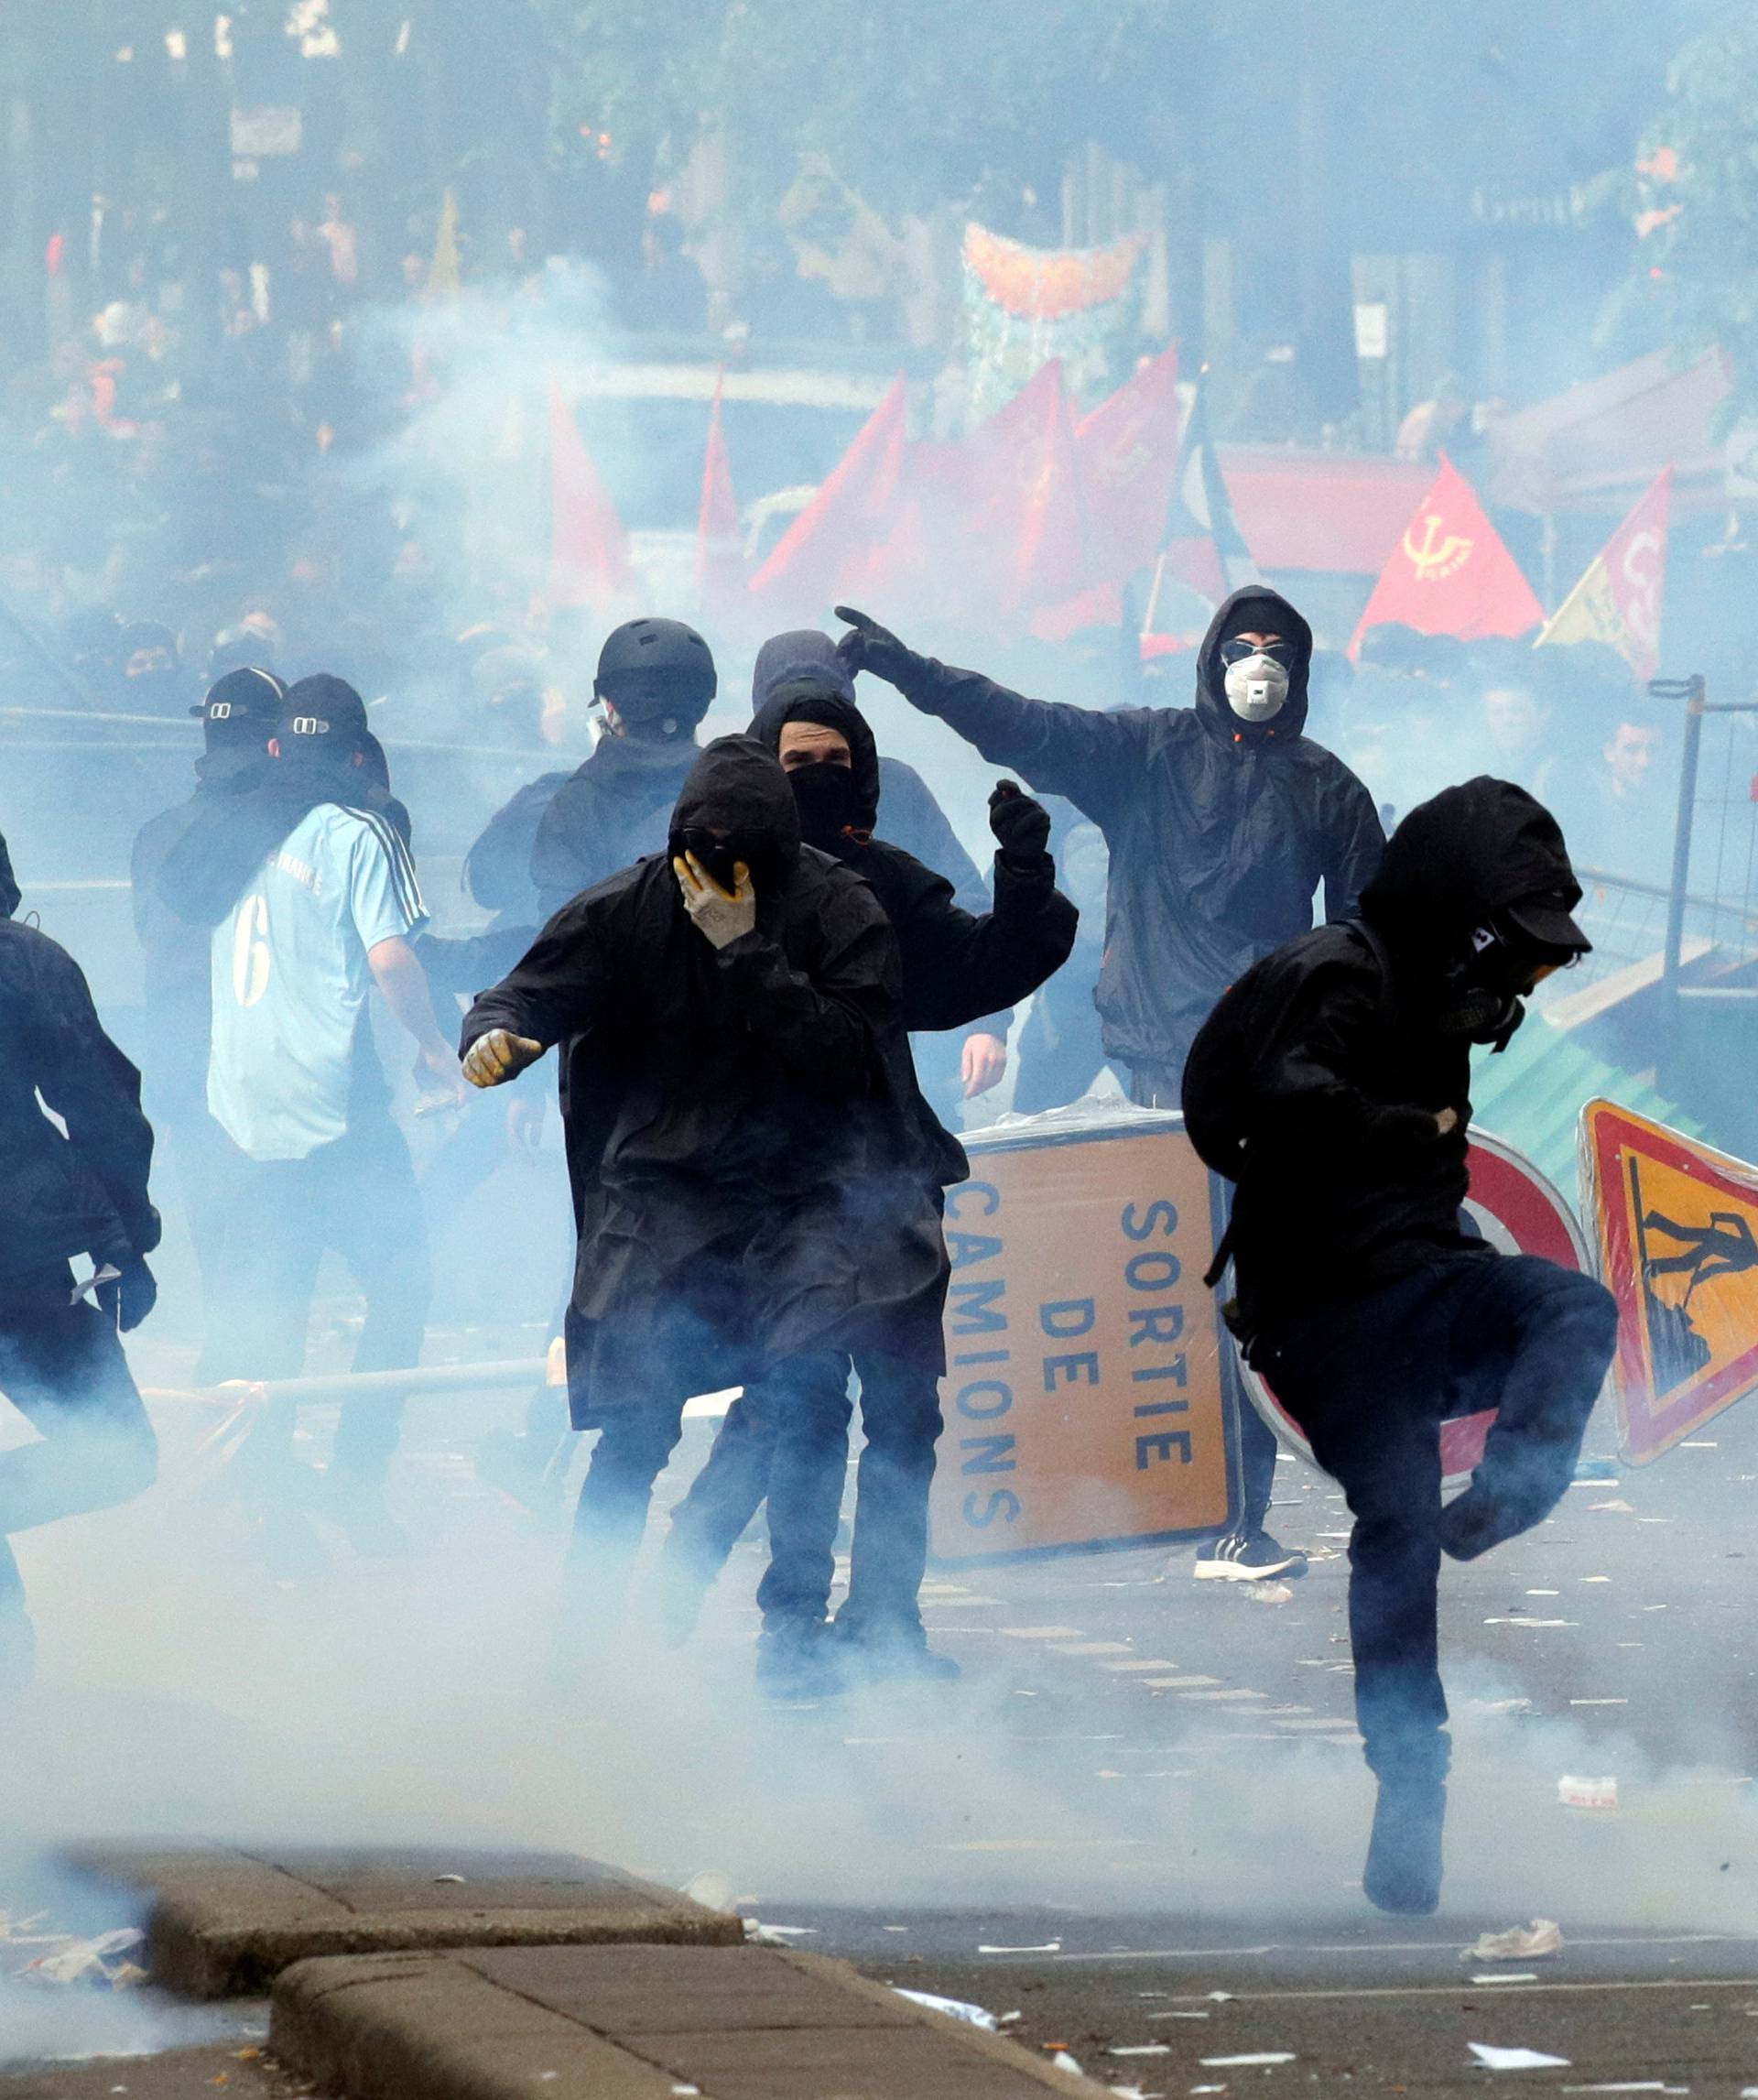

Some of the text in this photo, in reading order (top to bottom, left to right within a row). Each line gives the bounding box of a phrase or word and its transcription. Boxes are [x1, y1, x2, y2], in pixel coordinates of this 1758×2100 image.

[233, 894, 271, 1008] 6
[944, 1181, 1021, 1529] CAMIONS
[1039, 1297, 1099, 1392] DE
[1121, 1200, 1193, 1471] SORTIE
